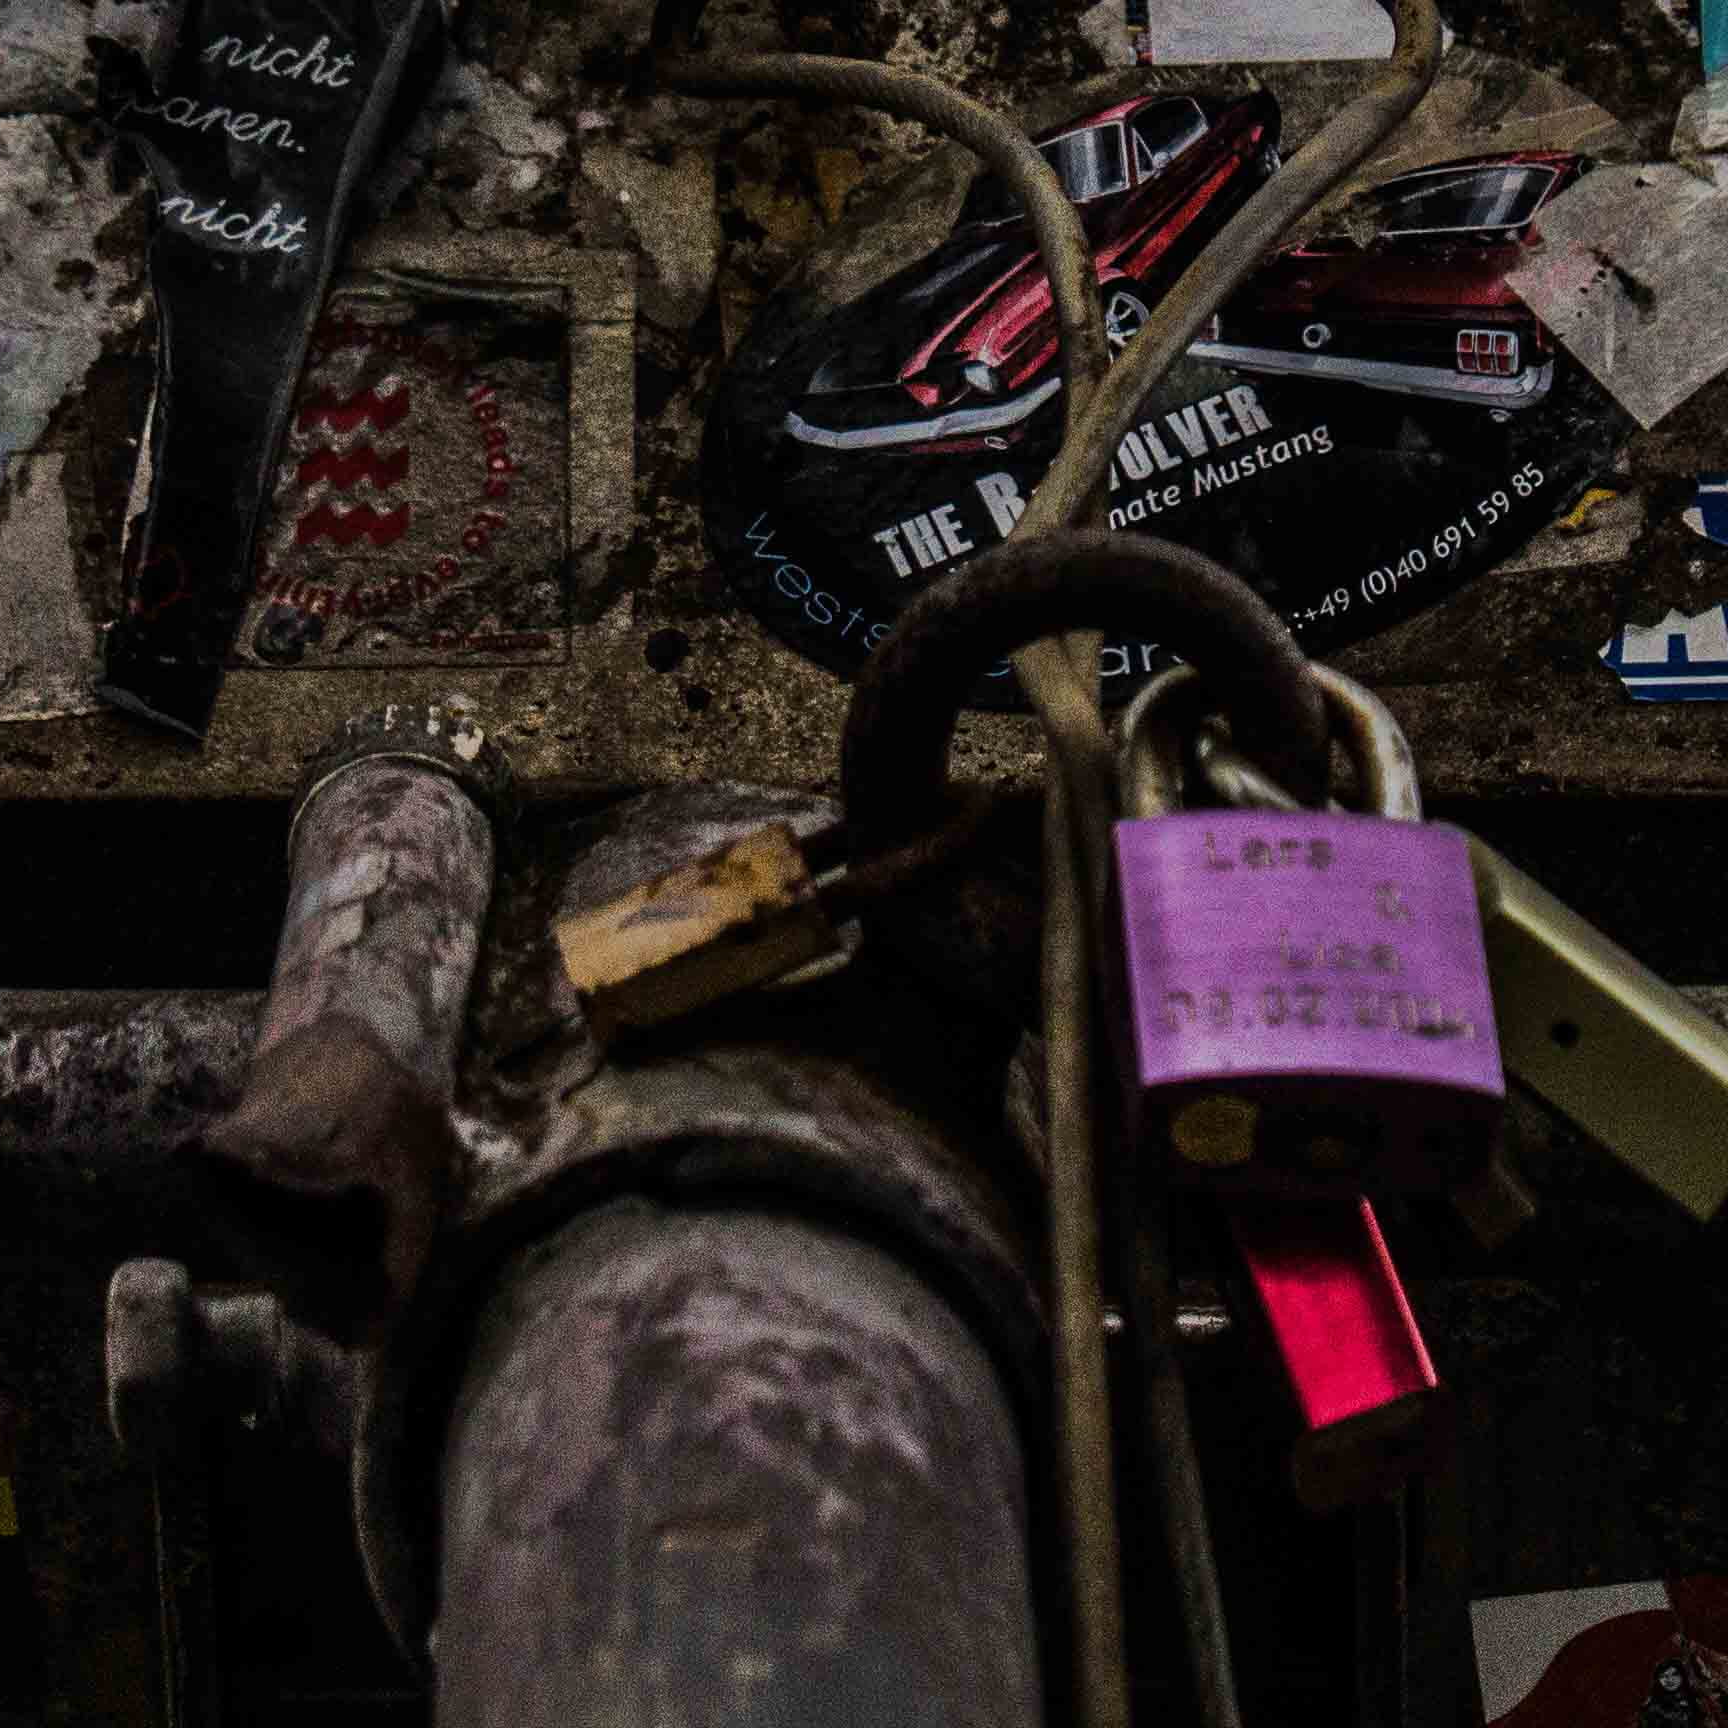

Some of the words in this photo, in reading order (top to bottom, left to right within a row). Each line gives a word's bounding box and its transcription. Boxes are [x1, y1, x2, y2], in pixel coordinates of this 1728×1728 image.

[206, 29, 357, 89] nicht
[156, 95, 307, 154] aren.
[159, 194, 307, 254] nicht
[1108, 484, 1182, 531] nate
[1193, 423, 1335, 498] Mustang
[873, 502, 974, 579] THE
[1360, 547, 1427, 606] (0)40
[1432, 516, 1477, 559] 691
[1477, 490, 1511, 526] 59
[1511, 460, 1545, 497] 85
